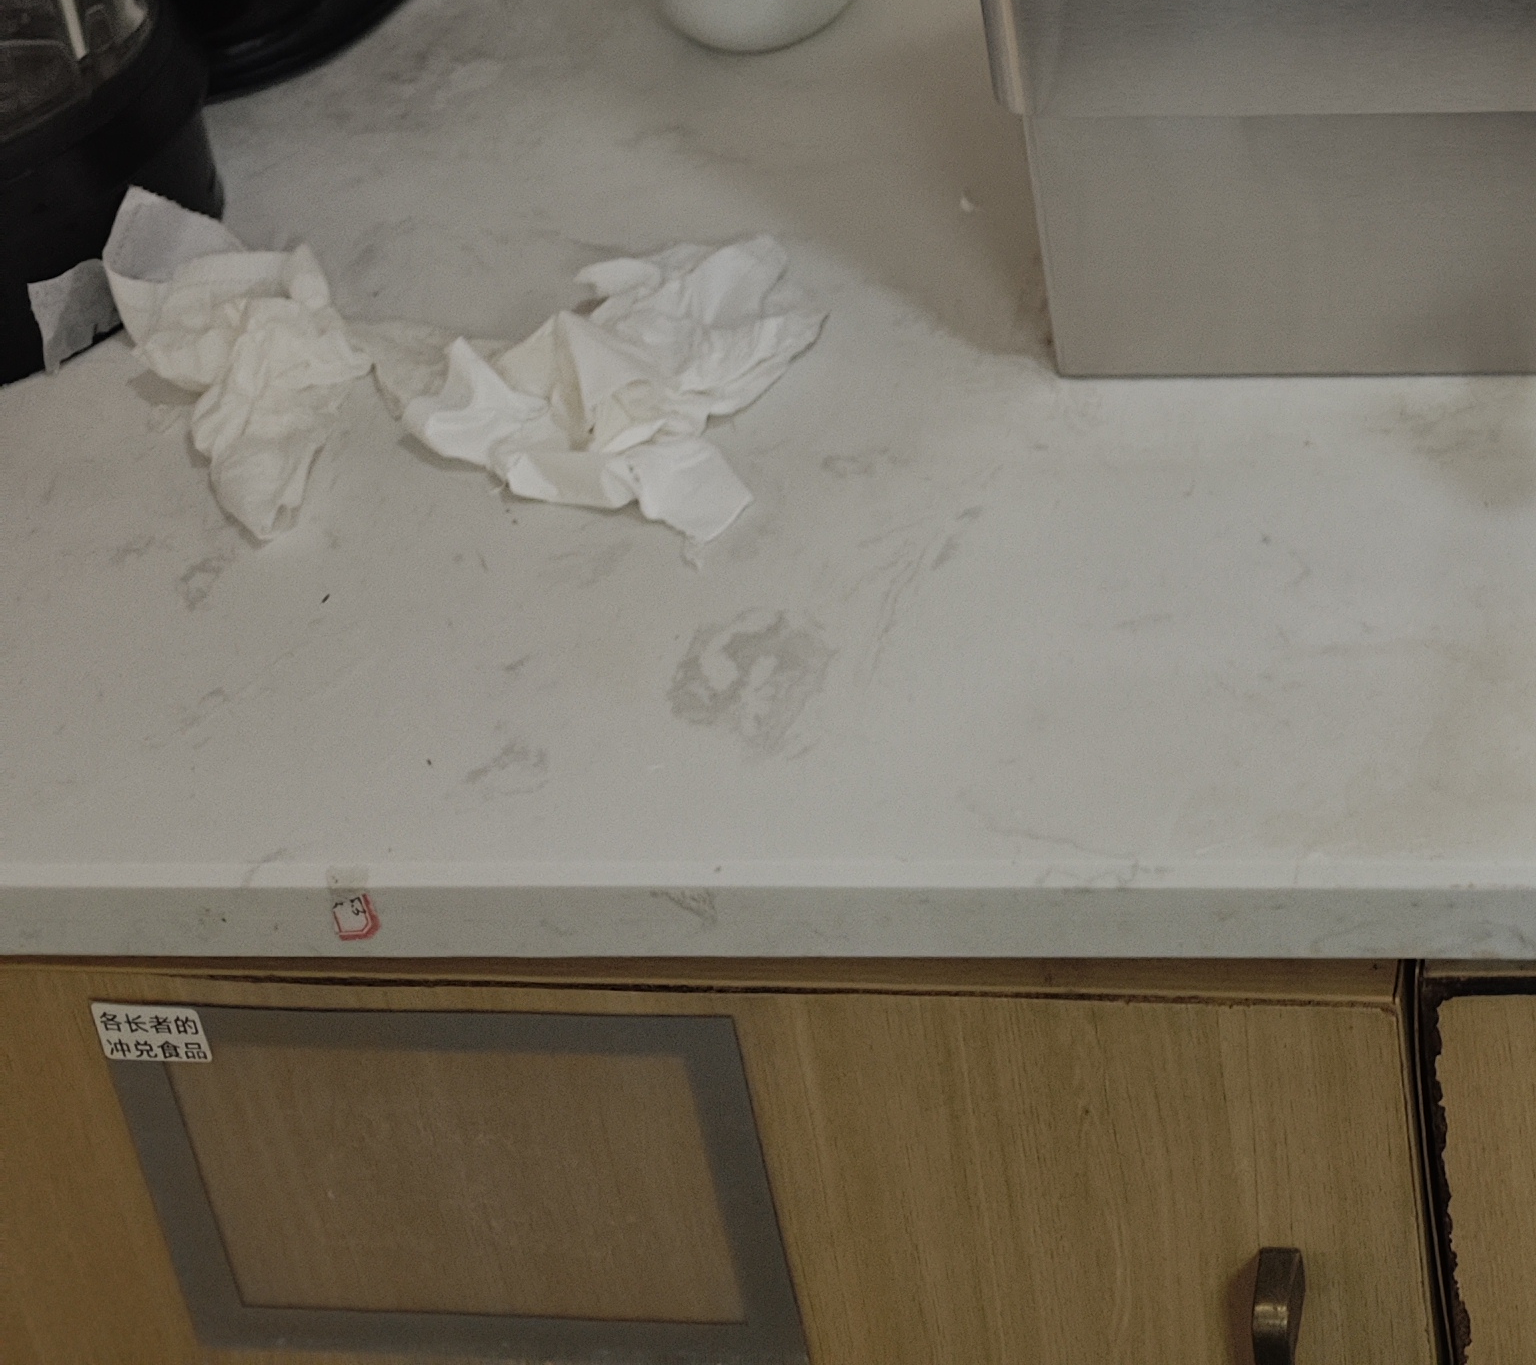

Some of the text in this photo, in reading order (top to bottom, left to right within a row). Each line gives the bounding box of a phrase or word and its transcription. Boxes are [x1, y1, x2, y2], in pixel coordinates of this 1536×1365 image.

[100, 1011, 200, 1035] 各长者的
[106, 1039, 208, 1060] 冲兑食品
